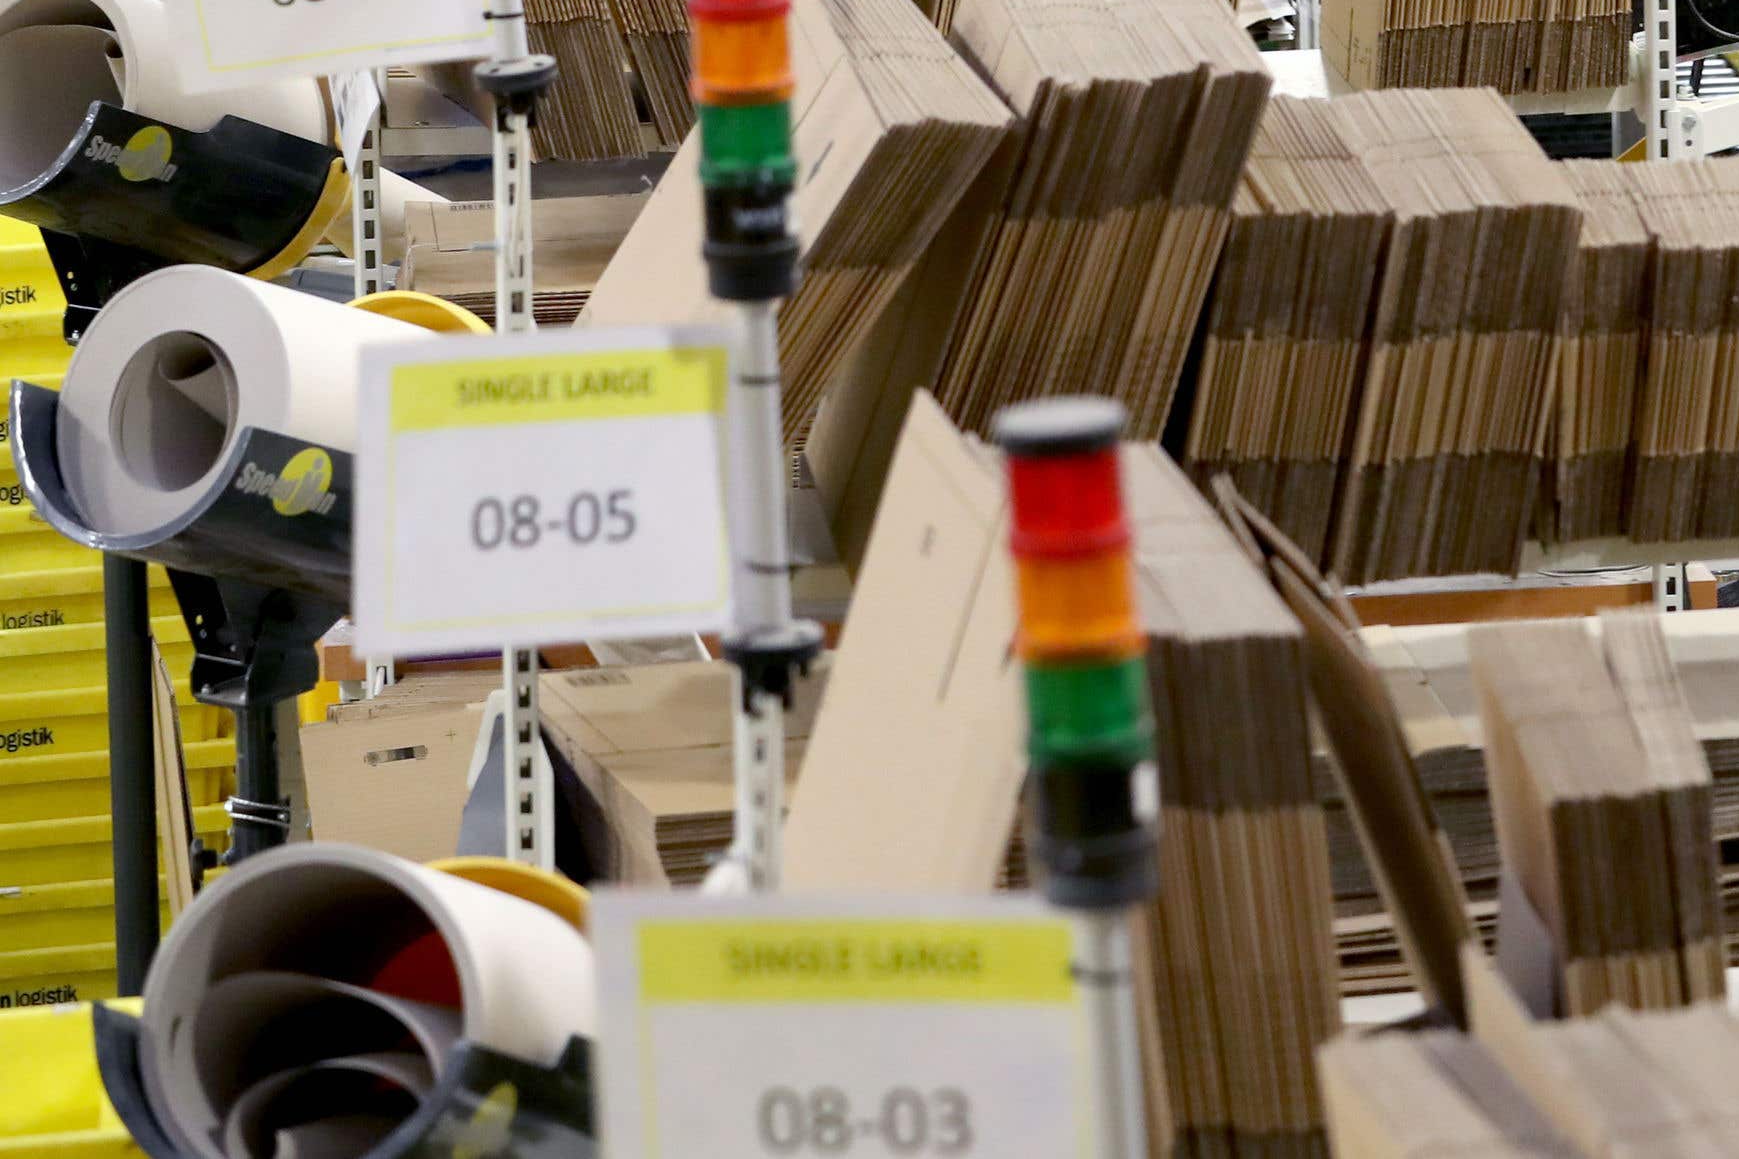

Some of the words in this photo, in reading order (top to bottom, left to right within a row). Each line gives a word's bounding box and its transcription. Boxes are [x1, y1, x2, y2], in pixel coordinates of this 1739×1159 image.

[455, 370, 551, 408] SINGLE
[560, 366, 654, 398] LARGE
[471, 488, 638, 552] 08-05
[2, 609, 64, 629] logistik
[724, 936, 852, 980] SINGLE
[868, 936, 984, 980] LARGE
[15, 983, 79, 1008] logistik
[757, 1084, 977, 1159] 08-03
